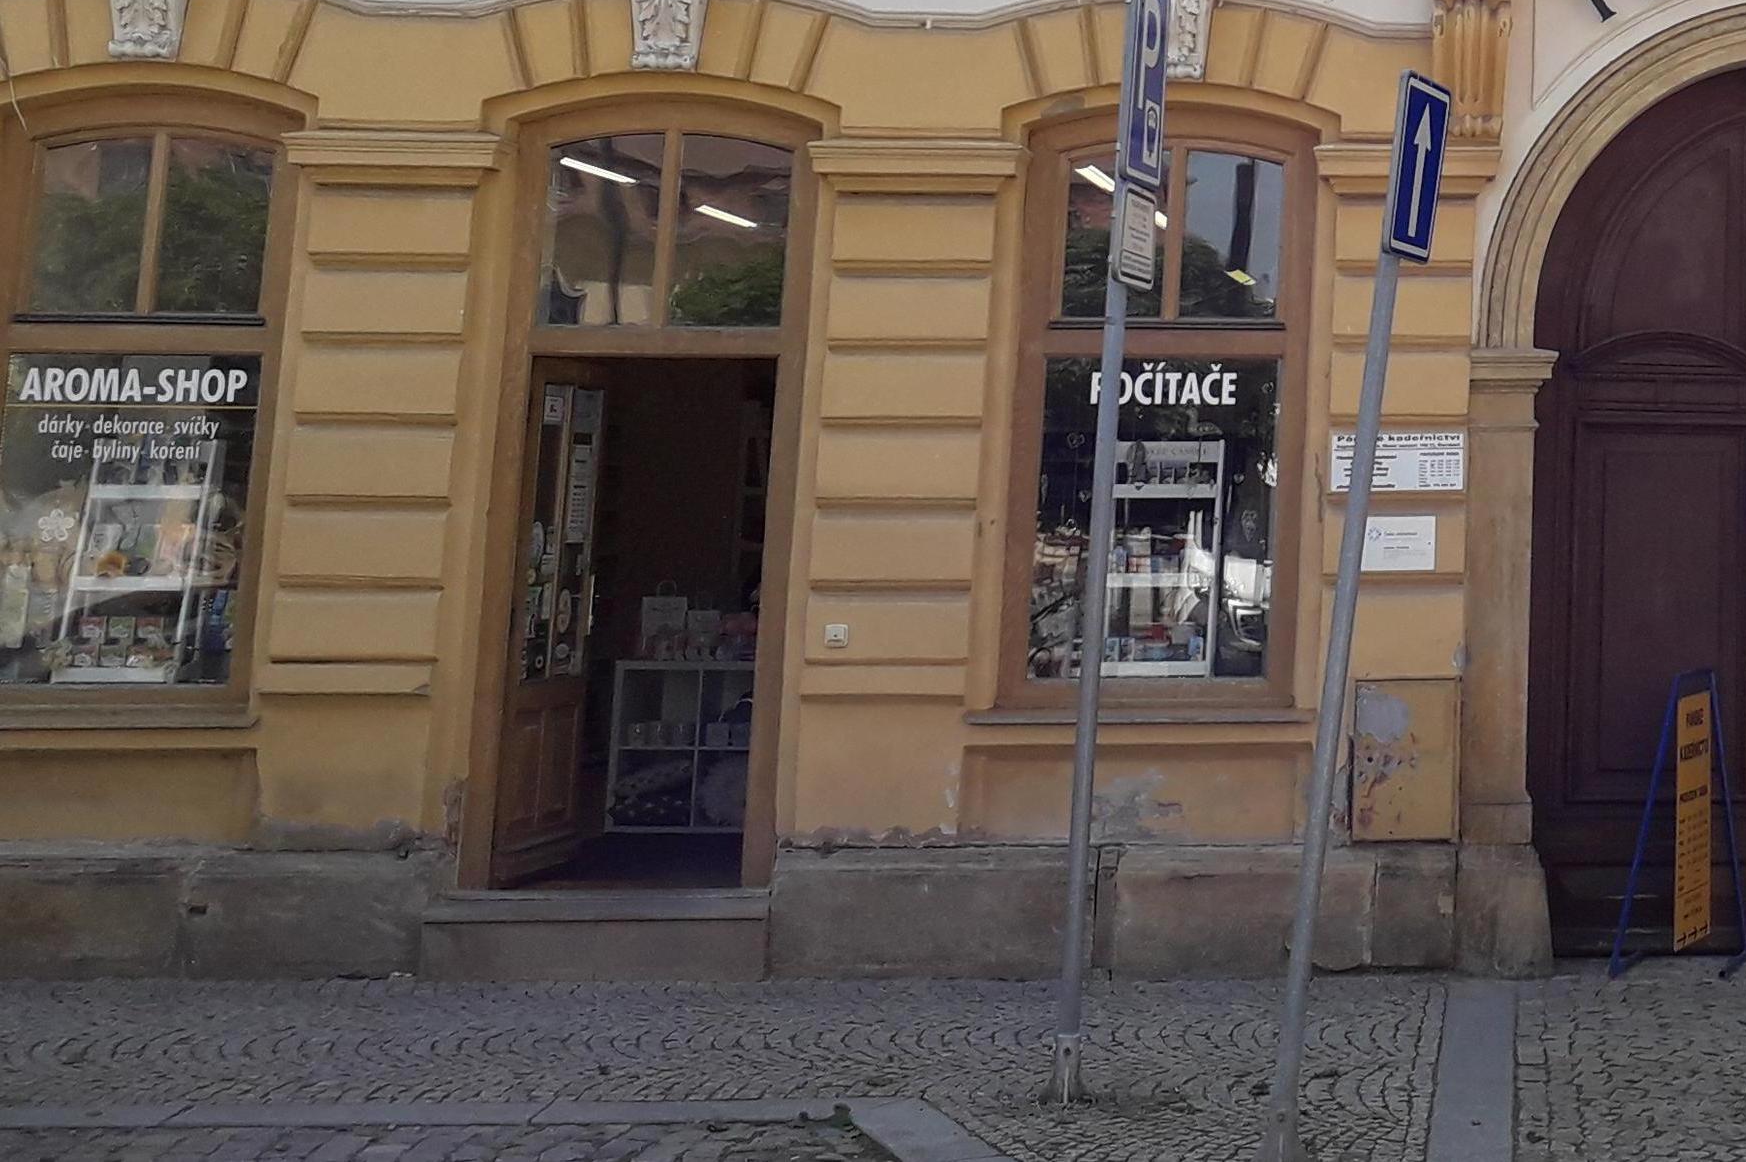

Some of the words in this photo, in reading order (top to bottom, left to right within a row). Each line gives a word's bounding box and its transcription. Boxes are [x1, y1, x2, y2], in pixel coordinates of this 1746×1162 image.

[19, 367, 248, 403] AROMA-SHOP
[38, 414, 86, 438] dárky
[93, 416, 164, 436] dekorace
[173, 416, 220, 438] svíčky
[51, 440, 82, 463] čaje
[92, 440, 141, 464] byliny
[150, 440, 201, 461] koření
